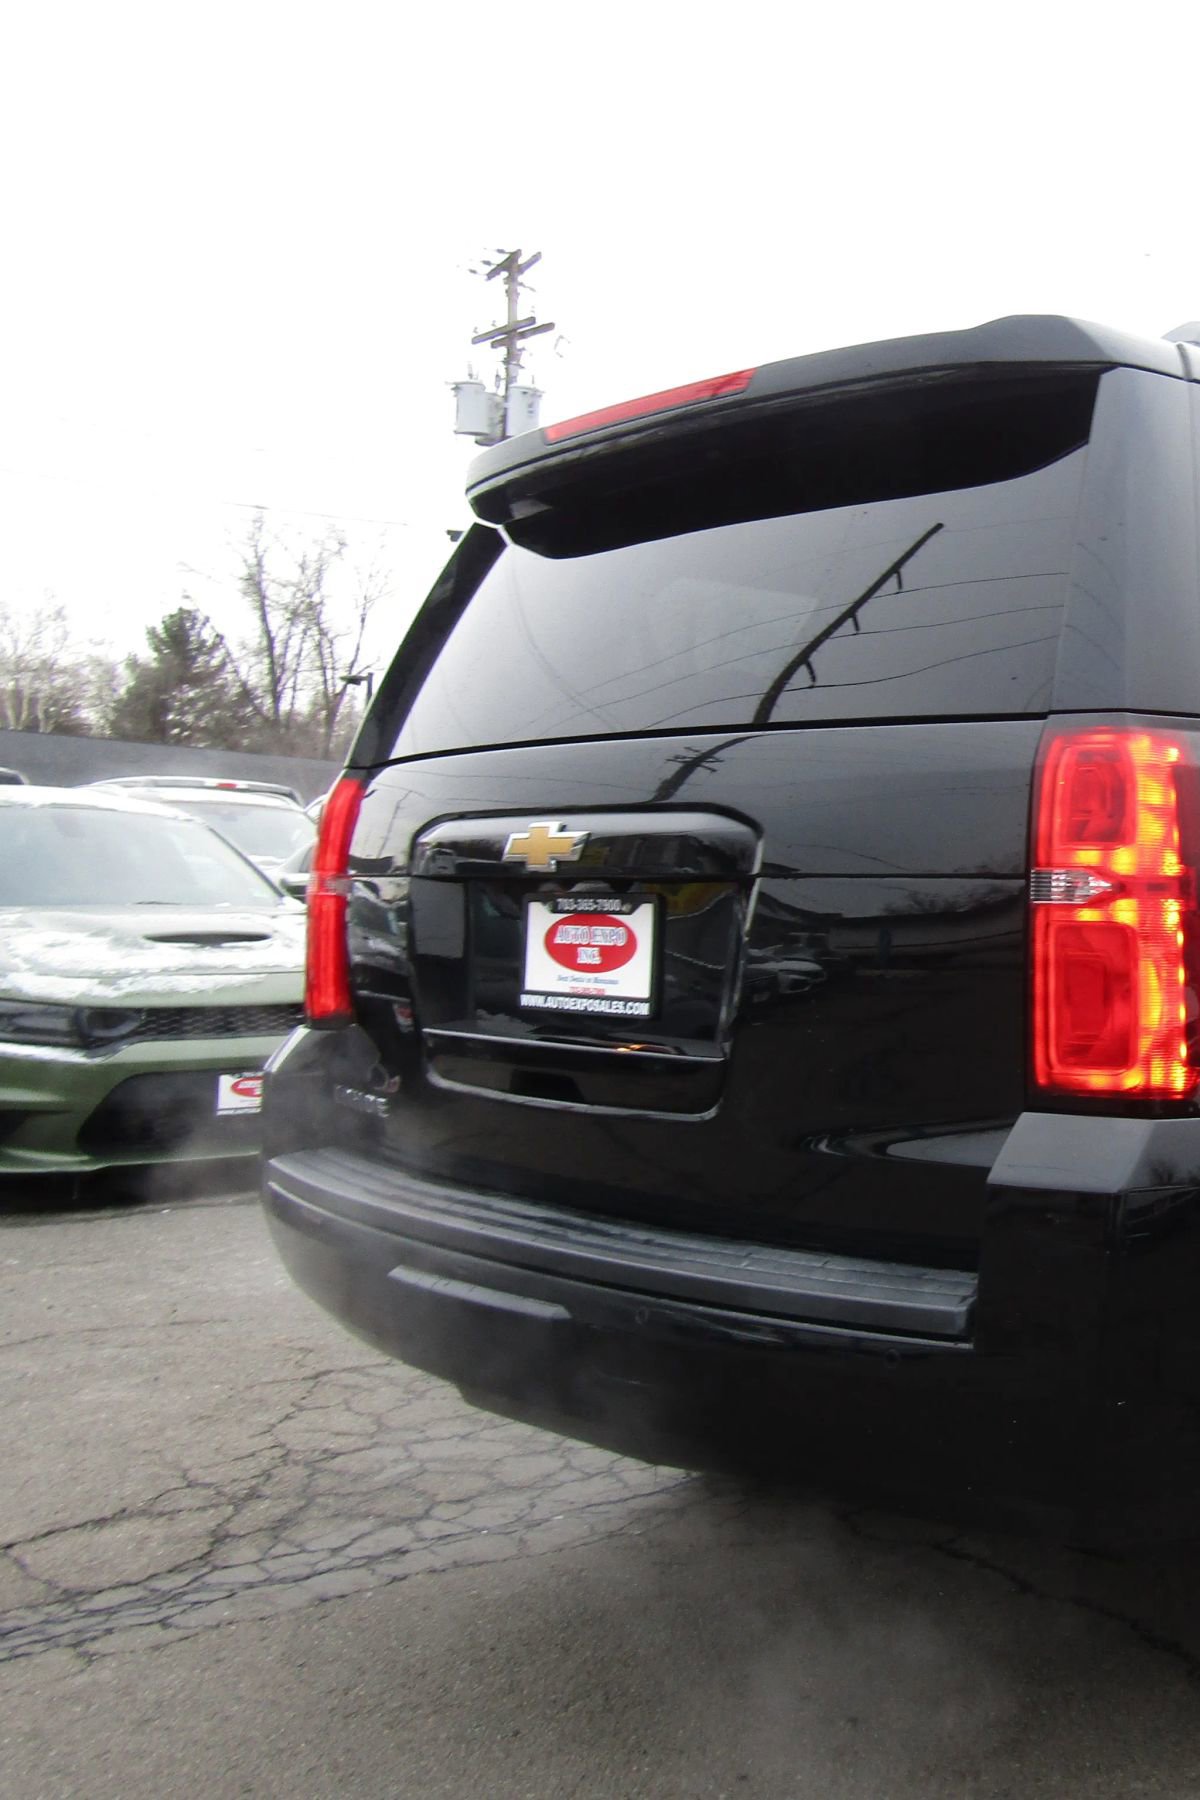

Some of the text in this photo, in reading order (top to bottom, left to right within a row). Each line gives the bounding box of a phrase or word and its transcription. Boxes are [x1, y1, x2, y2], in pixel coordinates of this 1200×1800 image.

[554, 925, 627, 946] AUTO EXPO
[520, 994, 650, 1015] WWW.AUTOEXPOSALES.COM
